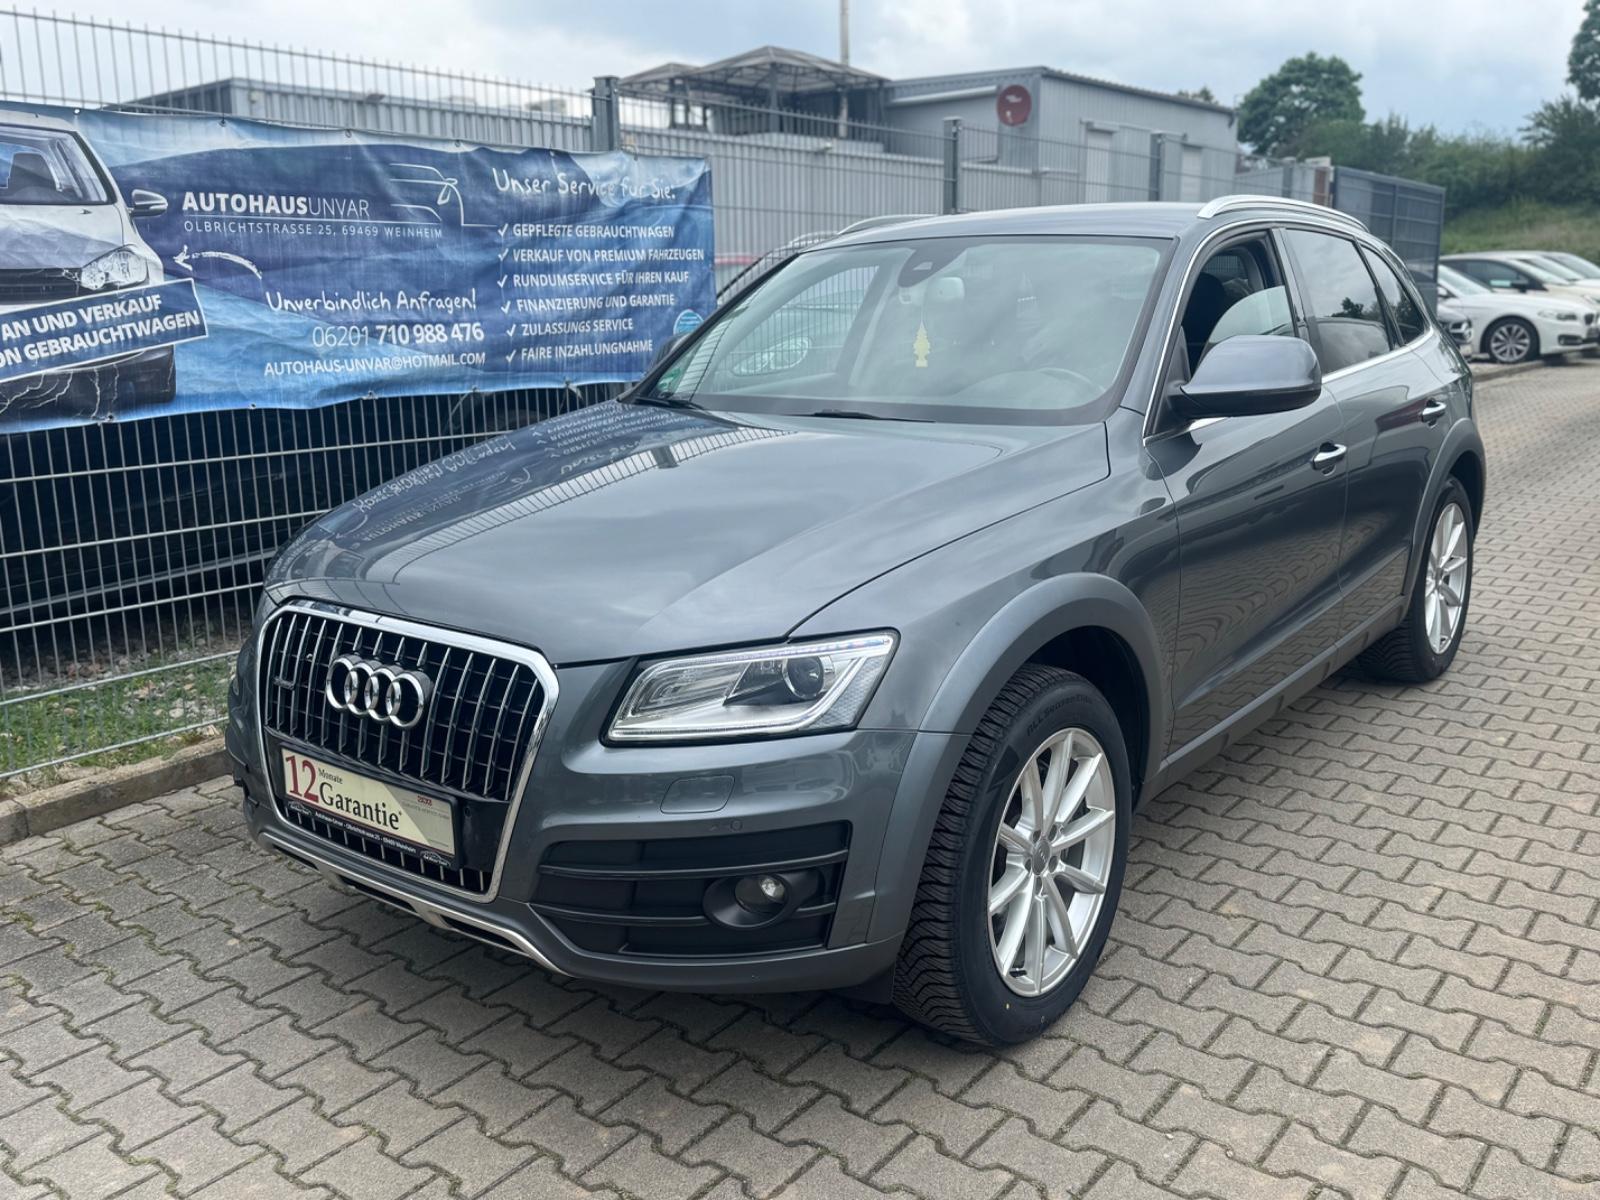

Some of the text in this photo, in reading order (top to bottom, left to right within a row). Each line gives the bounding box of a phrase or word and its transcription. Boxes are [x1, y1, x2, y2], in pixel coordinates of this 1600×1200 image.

[492, 167, 549, 195] Unser
[556, 172, 615, 197] Service
[184, 221, 442, 239] OLBRICHTSTRASSE 25, 69469 WEINHEIM
[513, 224, 674, 238] GEPFLEGTE GEBRAUCHTWAGEN
[512, 248, 705, 261] VERKAUF VON PREMIUM FAHRZEUGEN
[513, 270, 689, 287] RUNDUMSERVICE FÜR IHREN KAUF
[266, 288, 477, 314] Unverbindlich Anfragen!
[517, 294, 675, 312] FINANZIERUNG UND GARANTIE
[2, 294, 163, 341] AN UND VERKAUF
[521, 318, 634, 336] ZULASSUNGS SERVICE
[24, 310, 200, 361] GEBRAUCHTWAGEN
[312, 322, 485, 347] 06201 710 988 476
[521, 340, 653, 361] FAIRE INZAHLUNGNAHME
[286, 756, 319, 803] 12
[318, 768, 343, 784] Monate
